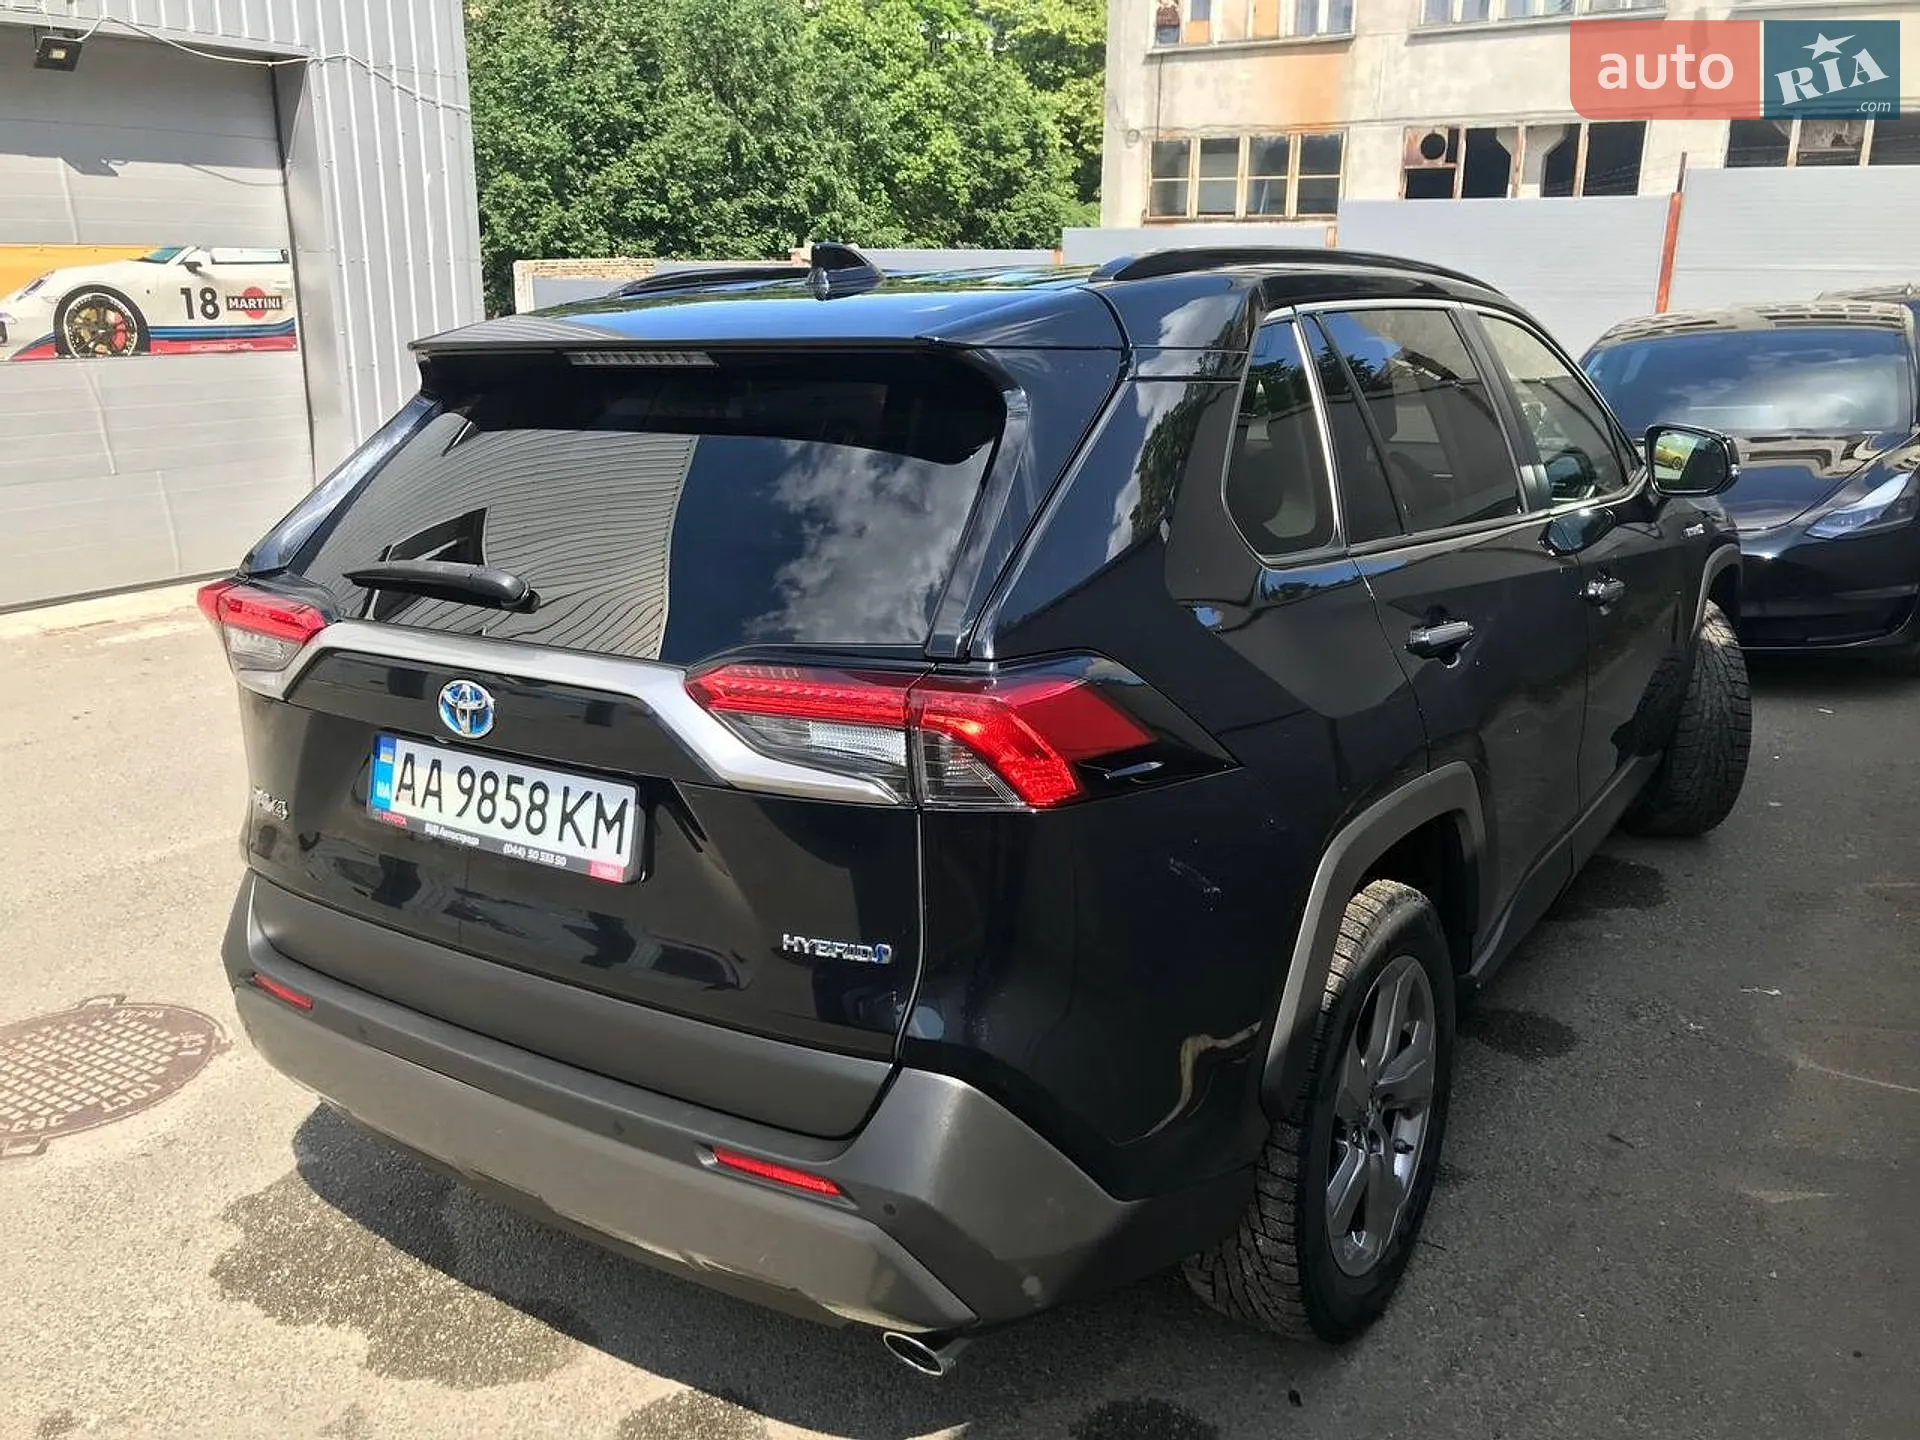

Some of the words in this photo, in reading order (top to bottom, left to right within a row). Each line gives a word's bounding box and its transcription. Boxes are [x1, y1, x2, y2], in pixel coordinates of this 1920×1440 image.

[180, 287, 220, 320] 18
[227, 297, 281, 310] MARTINI
[395, 753, 443, 814] AA
[456, 765, 550, 836] 9858
[558, 786, 629, 855] KM
[782, 933, 874, 962] HYBRID
